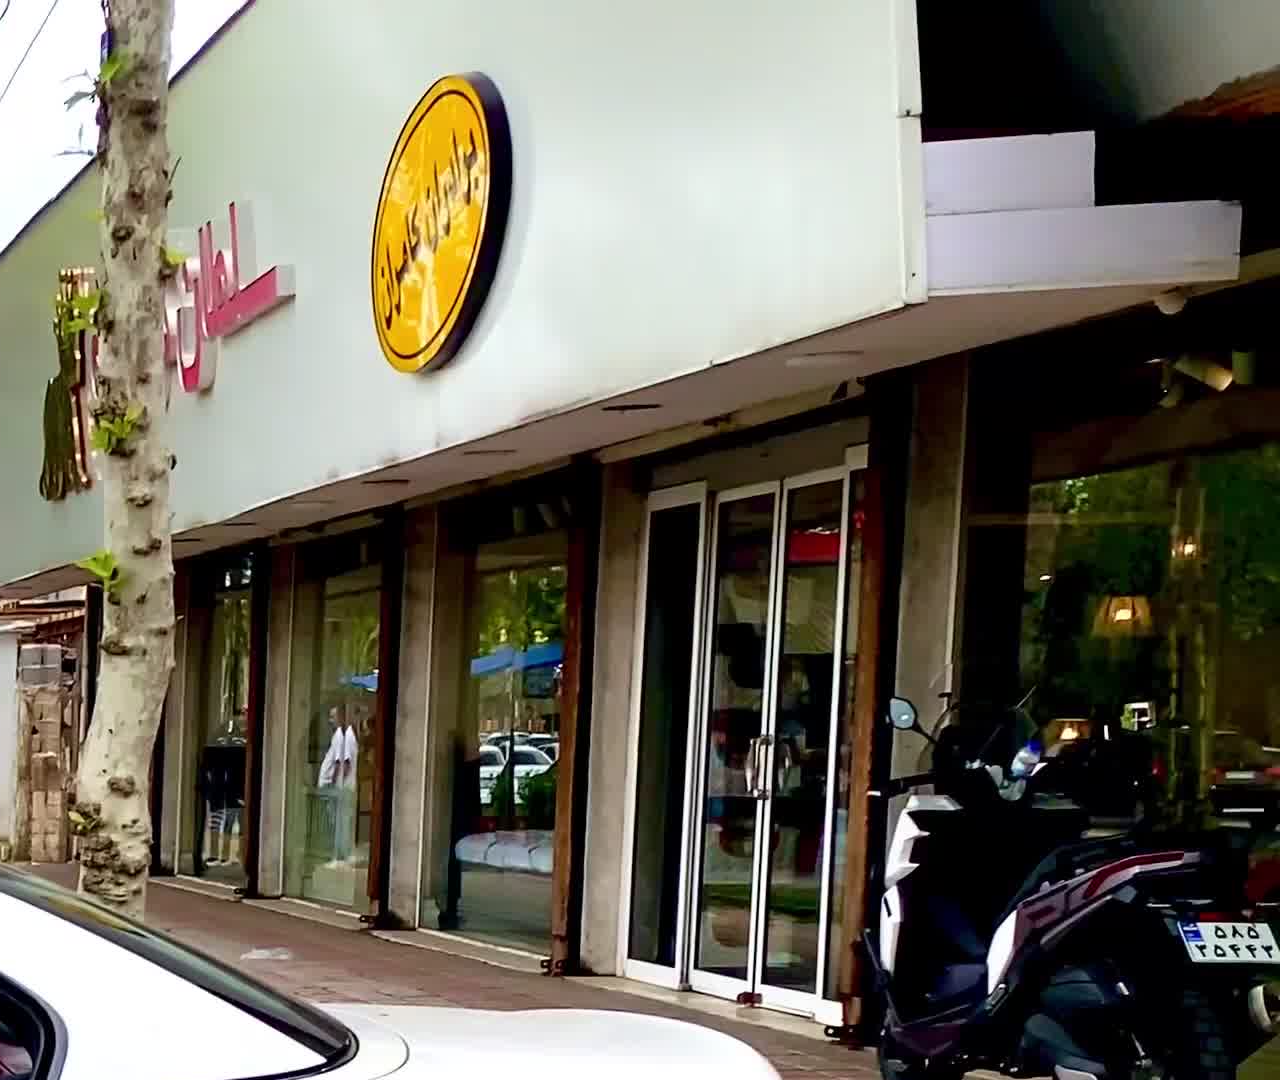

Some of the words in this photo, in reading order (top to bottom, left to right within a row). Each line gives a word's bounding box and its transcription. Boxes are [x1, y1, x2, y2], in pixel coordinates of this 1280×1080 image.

[425, 127, 479, 256] برادران
[380, 200, 422, 331] کامران
[1214, 925, 1260, 939] ۵۸۵
